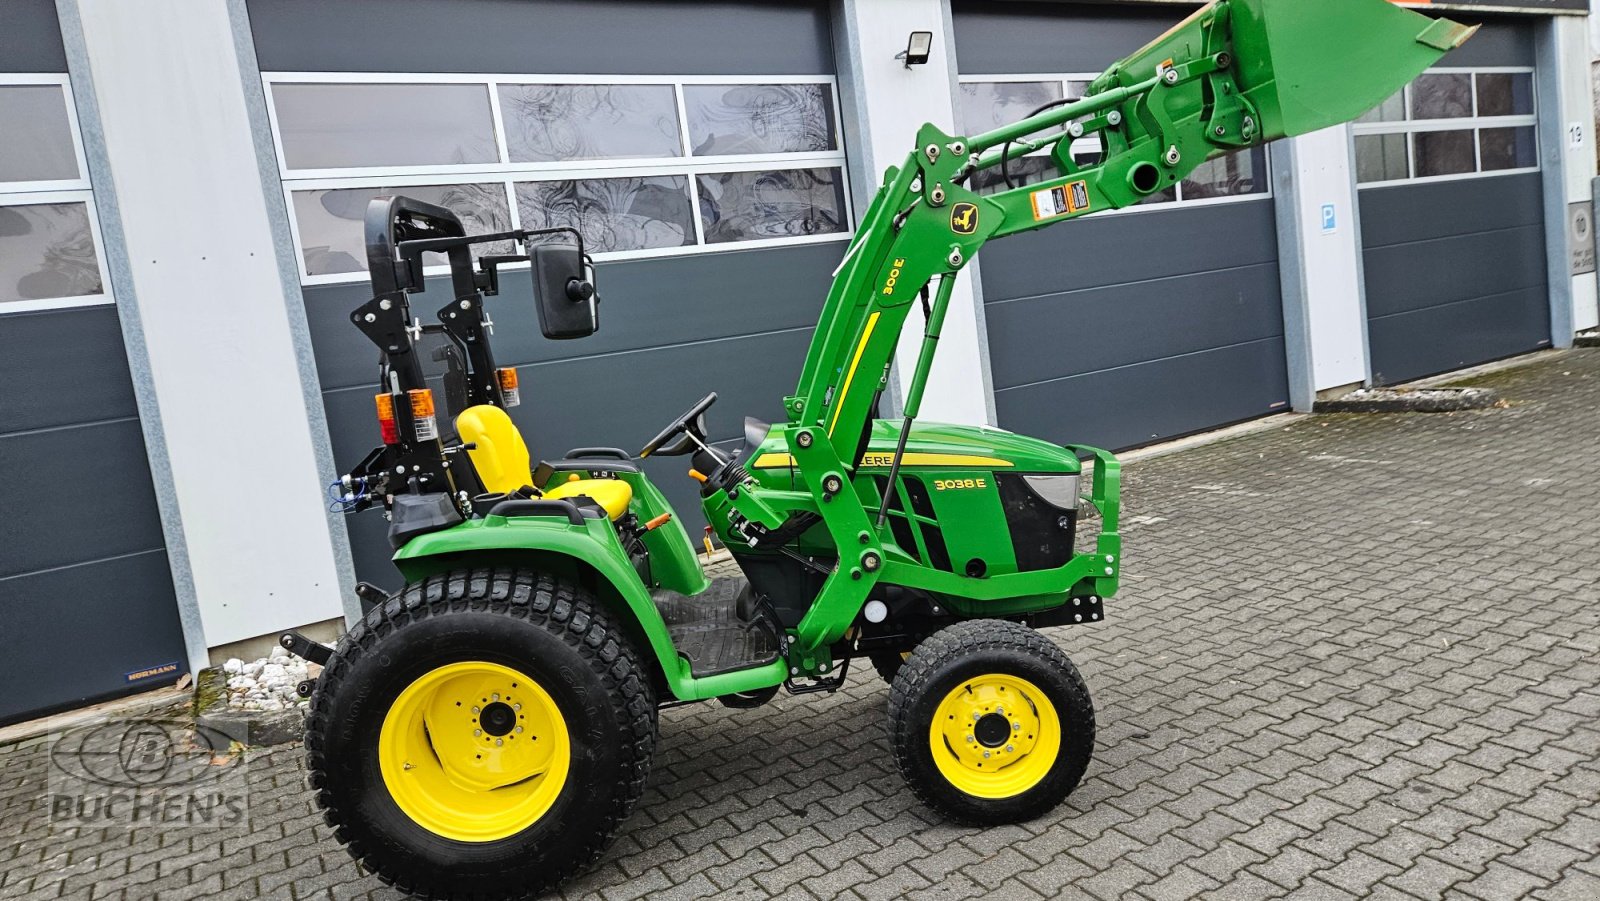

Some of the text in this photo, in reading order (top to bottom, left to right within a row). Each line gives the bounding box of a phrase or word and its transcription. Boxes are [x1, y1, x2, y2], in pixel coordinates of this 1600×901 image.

[1569, 126, 1582, 142] 19
[1323, 206, 1333, 228] P
[882, 258, 905, 295] 300E
